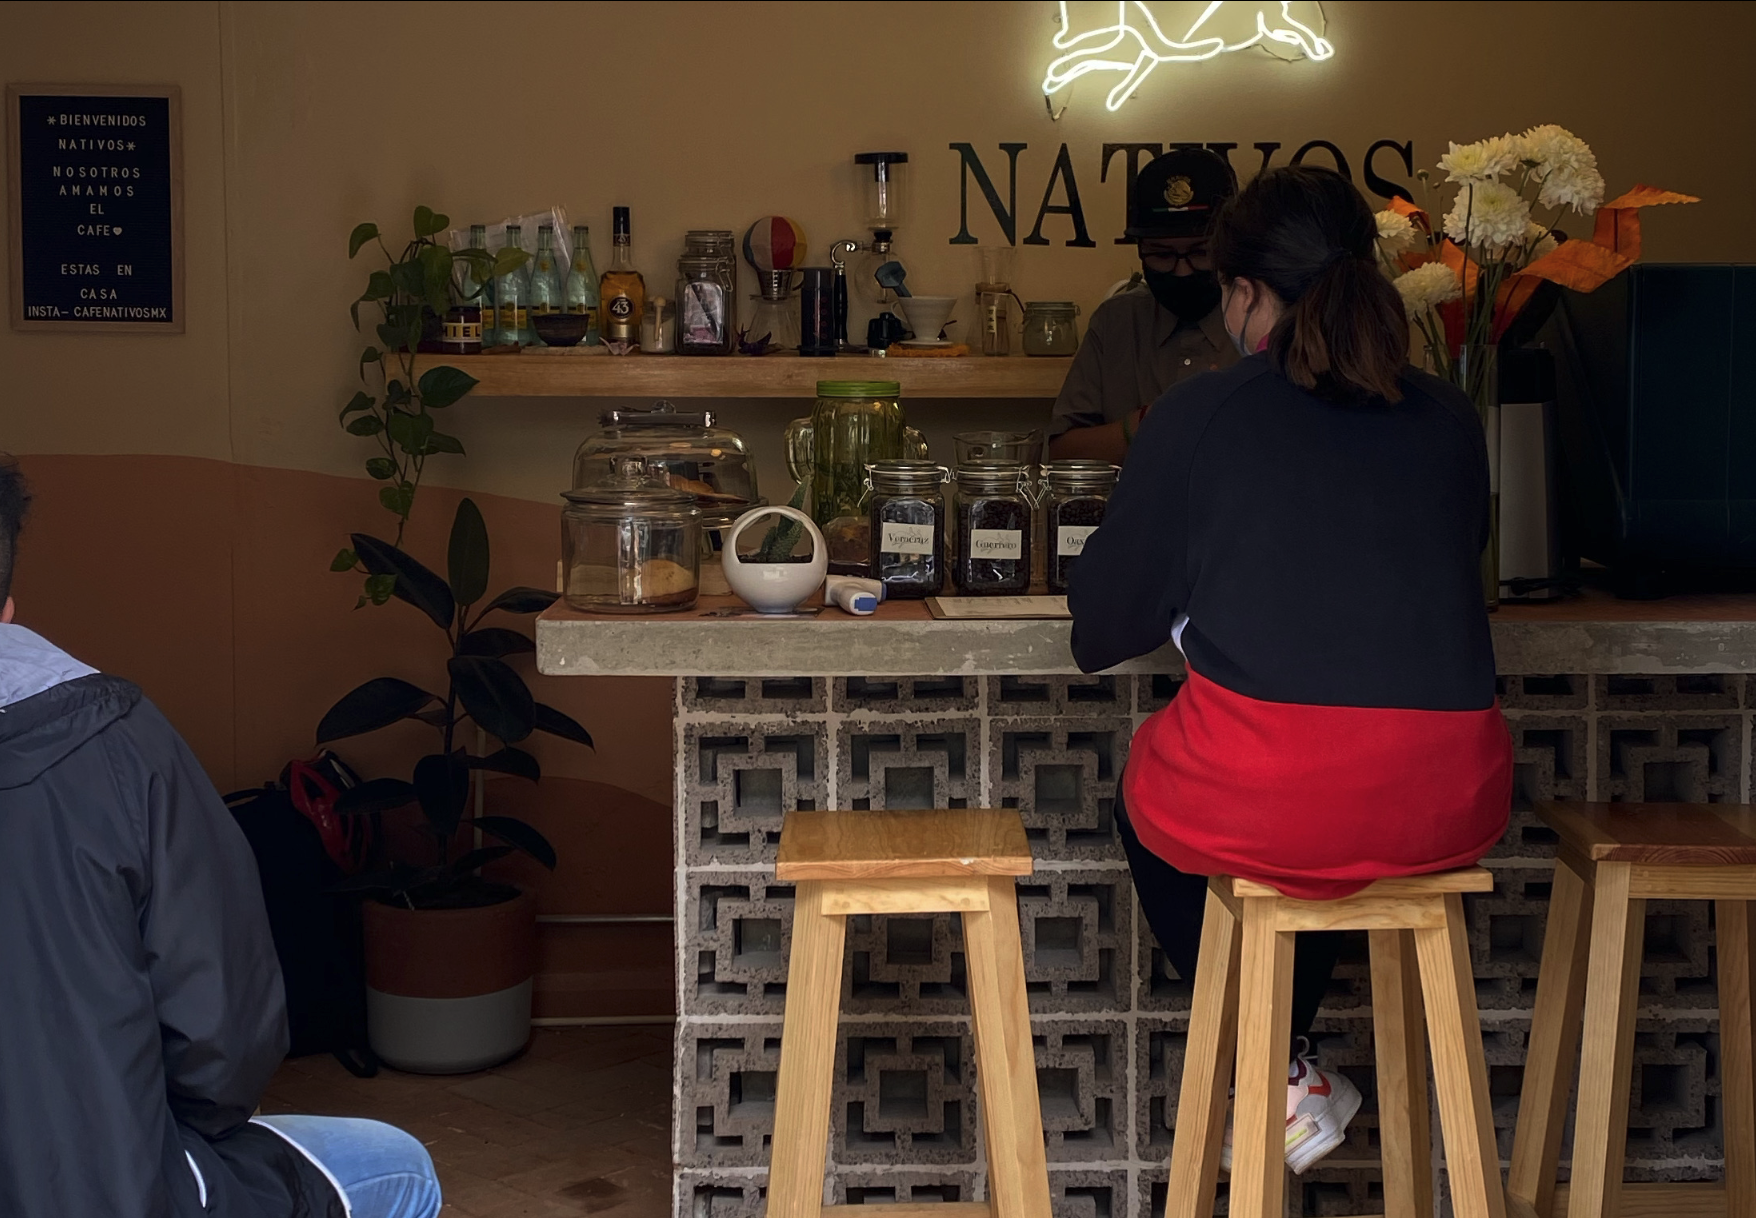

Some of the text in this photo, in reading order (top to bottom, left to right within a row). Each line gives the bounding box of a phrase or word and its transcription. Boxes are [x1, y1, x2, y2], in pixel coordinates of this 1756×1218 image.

[53, 165, 141, 178] NOSOTROS
[59, 184, 135, 197] AMAMOS
[949, 139, 1414, 248] NATS
[89, 203, 105, 215] EL
[77, 224, 111, 236] CAFE
[61, 263, 132, 276] ESTAS EN
[80, 287, 118, 300] CASA
[73, 306, 167, 318] CAFENATIVOSMX
[610, 300, 630, 315] 43
[887, 532, 930, 545] Veracruz
